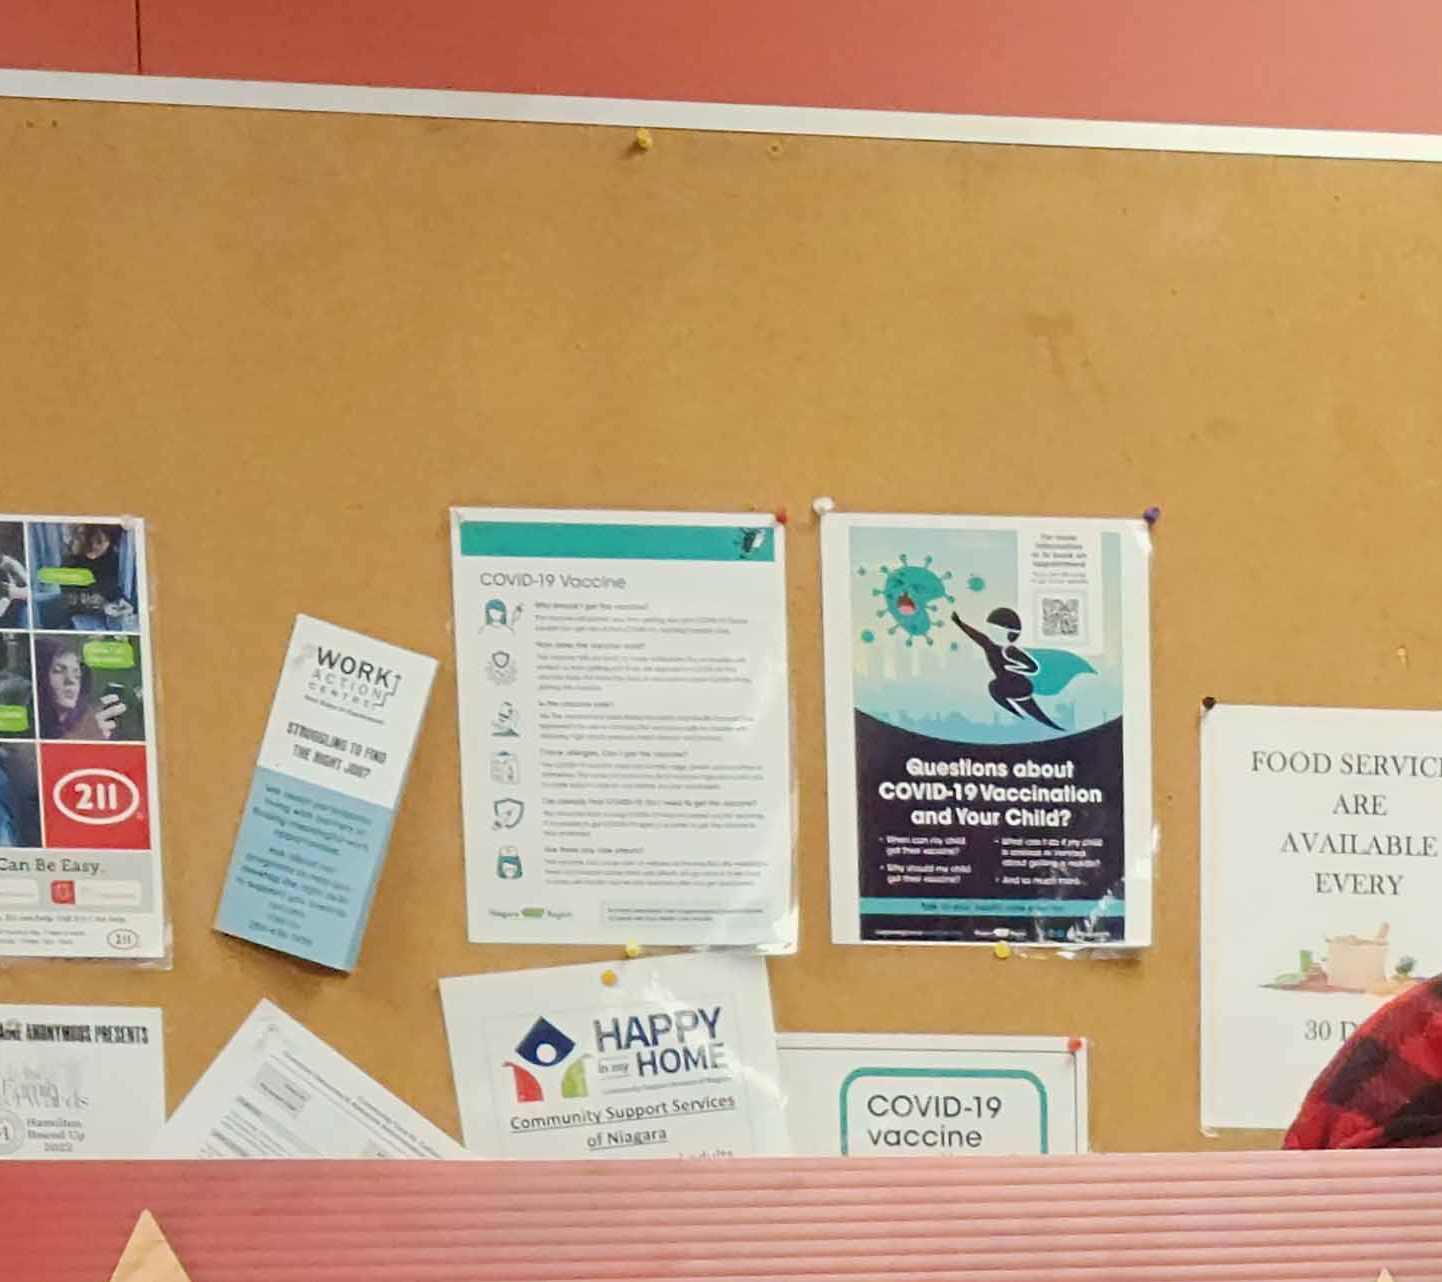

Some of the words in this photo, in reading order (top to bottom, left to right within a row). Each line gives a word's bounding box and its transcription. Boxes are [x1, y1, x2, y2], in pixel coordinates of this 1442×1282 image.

[479, 572, 556, 588] COVID-19
[559, 573, 627, 590] Vaccine
[317, 646, 394, 688] WORK
[312, 669, 383, 700] ACTION
[906, 758, 1009, 777] Questions
[1013, 760, 1076, 779] about
[1251, 750, 1332, 774] FOOD
[74, 783, 118, 811] 211
[878, 782, 979, 801] COVID-19
[980, 784, 1104, 803] Vaccination
[1332, 794, 1388, 816] ARE
[910, 808, 952, 826] and
[956, 808, 1001, 826] Your
[1005, 809, 1072, 828] Child?
[1280, 832, 1439, 858] AVAILABLE
[36, 857, 56, 872] Be
[1314, 872, 1404, 895] EVERY
[26, 1023, 93, 1044] ANONYMOUS
[94, 1024, 150, 1045] PRESENTS
[594, 1005, 723, 1053] HAPPY
[1304, 1020, 1331, 1041] 30
[636, 1042, 727, 1078] HOME
[510, 1109, 603, 1132] Community
[606, 1103, 668, 1124] Support
[671, 1093, 737, 1115] Services
[866, 1093, 1003, 1119] COVID-19
[586, 1132, 605, 1149] of
[607, 1126, 669, 1147] Niagara
[867, 1124, 984, 1149] vaccine
